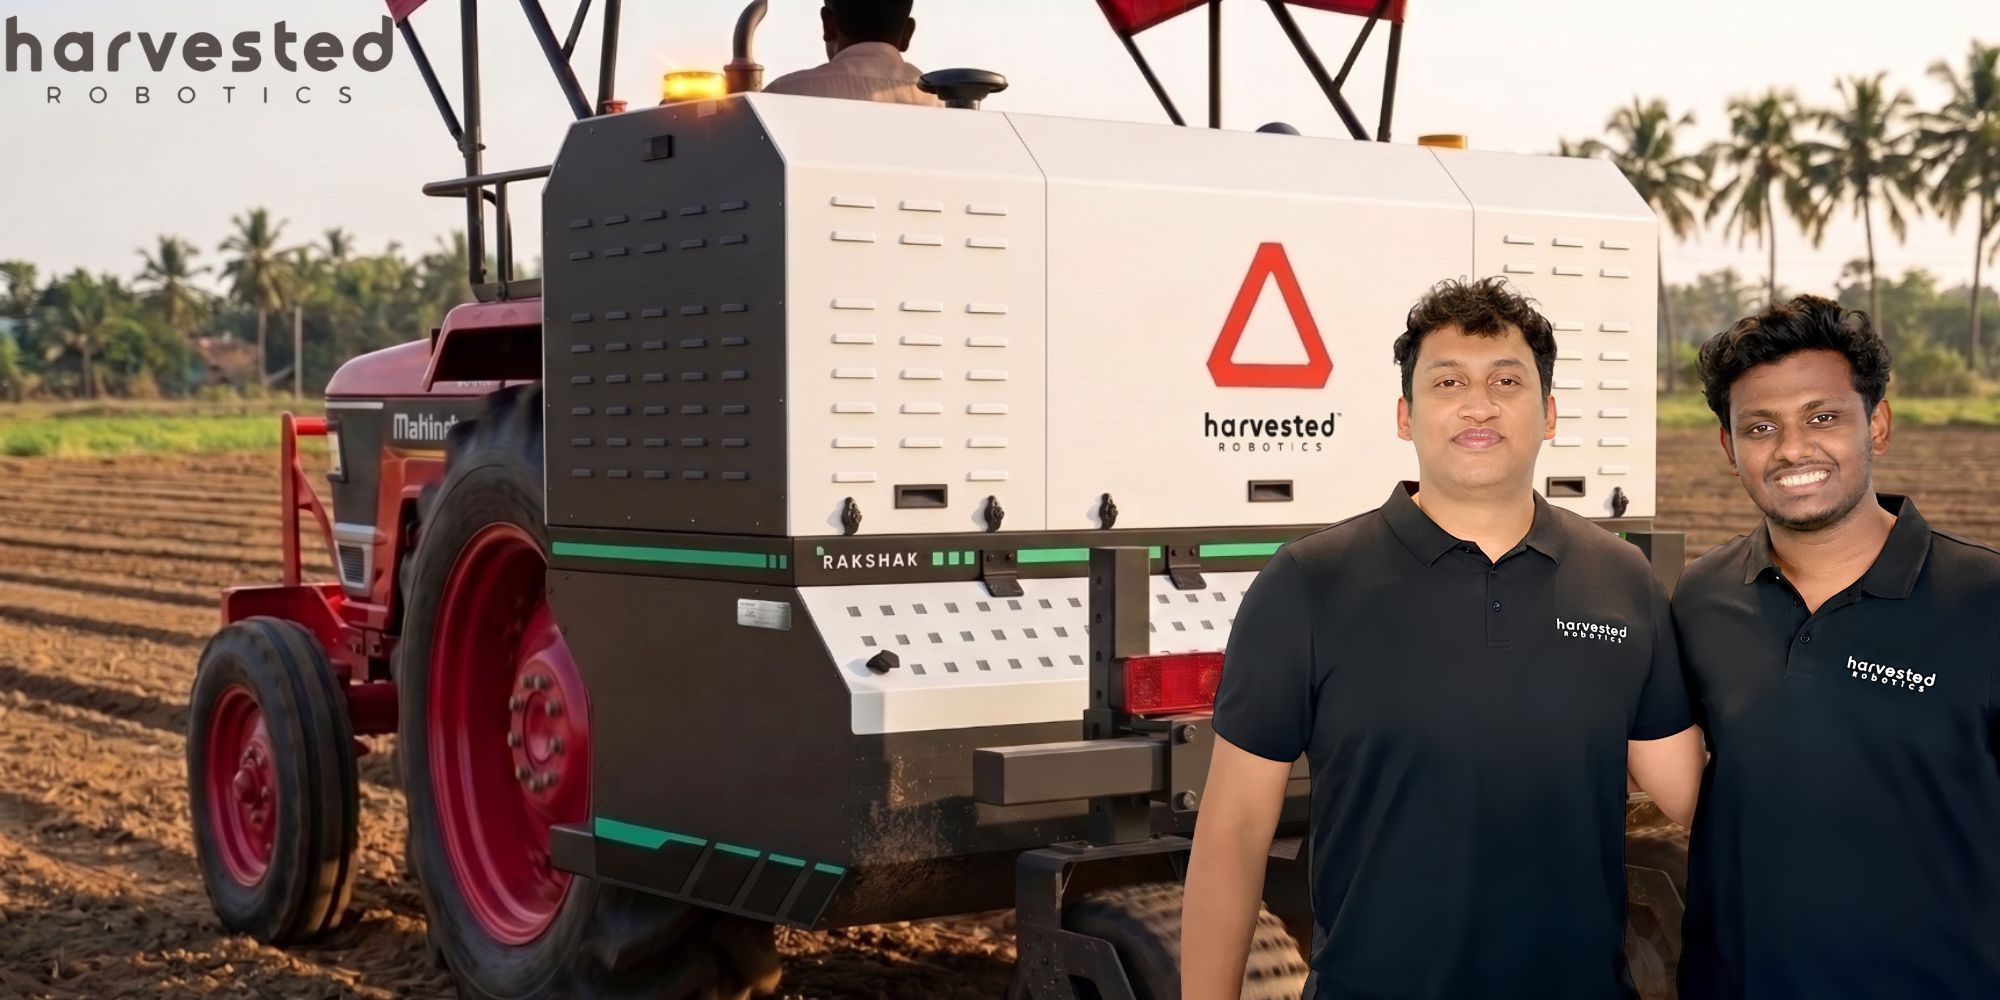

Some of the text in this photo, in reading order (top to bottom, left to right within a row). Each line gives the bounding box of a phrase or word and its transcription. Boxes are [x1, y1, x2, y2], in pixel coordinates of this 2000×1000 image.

[1204, 411, 1336, 438] harvested
[1218, 442, 1323, 452] ROBOTICS
[823, 552, 919, 570] RAKSHAK
[1556, 617, 1627, 638] harvested
[1847, 655, 1936, 687] harvested
